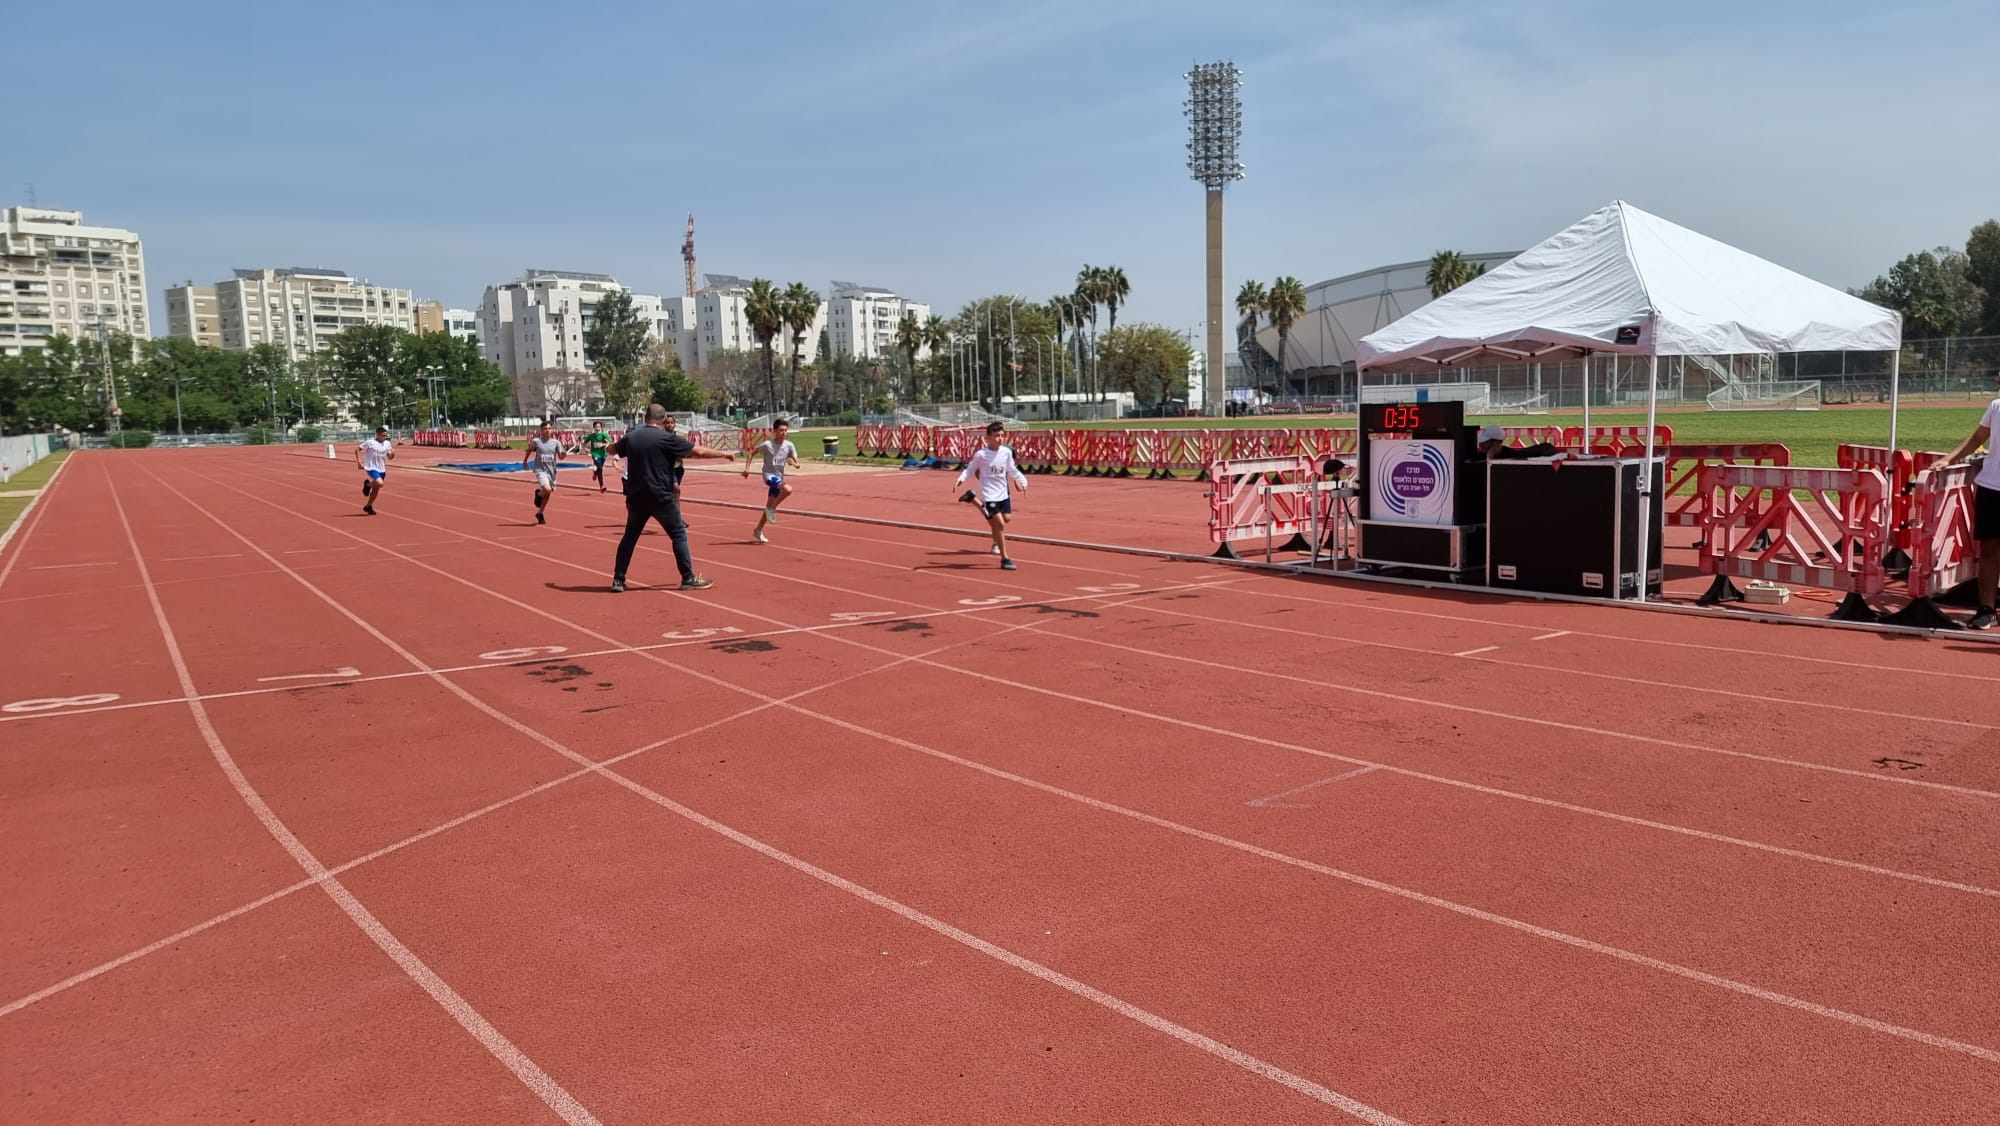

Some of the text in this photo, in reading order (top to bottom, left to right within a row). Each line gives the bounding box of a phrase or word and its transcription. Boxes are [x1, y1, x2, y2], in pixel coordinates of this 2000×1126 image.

[1384, 407, 1420, 428] 0:35
[1412, 476, 1434, 485] הספורט
[1075, 583, 1141, 592] 2
[958, 595, 1022, 605] 3
[829, 611, 896, 621] 4
[662, 626, 744, 639] 5
[478, 645, 568, 660] 6
[257, 667, 362, 683] 7
[1, 693, 120, 713] 8
